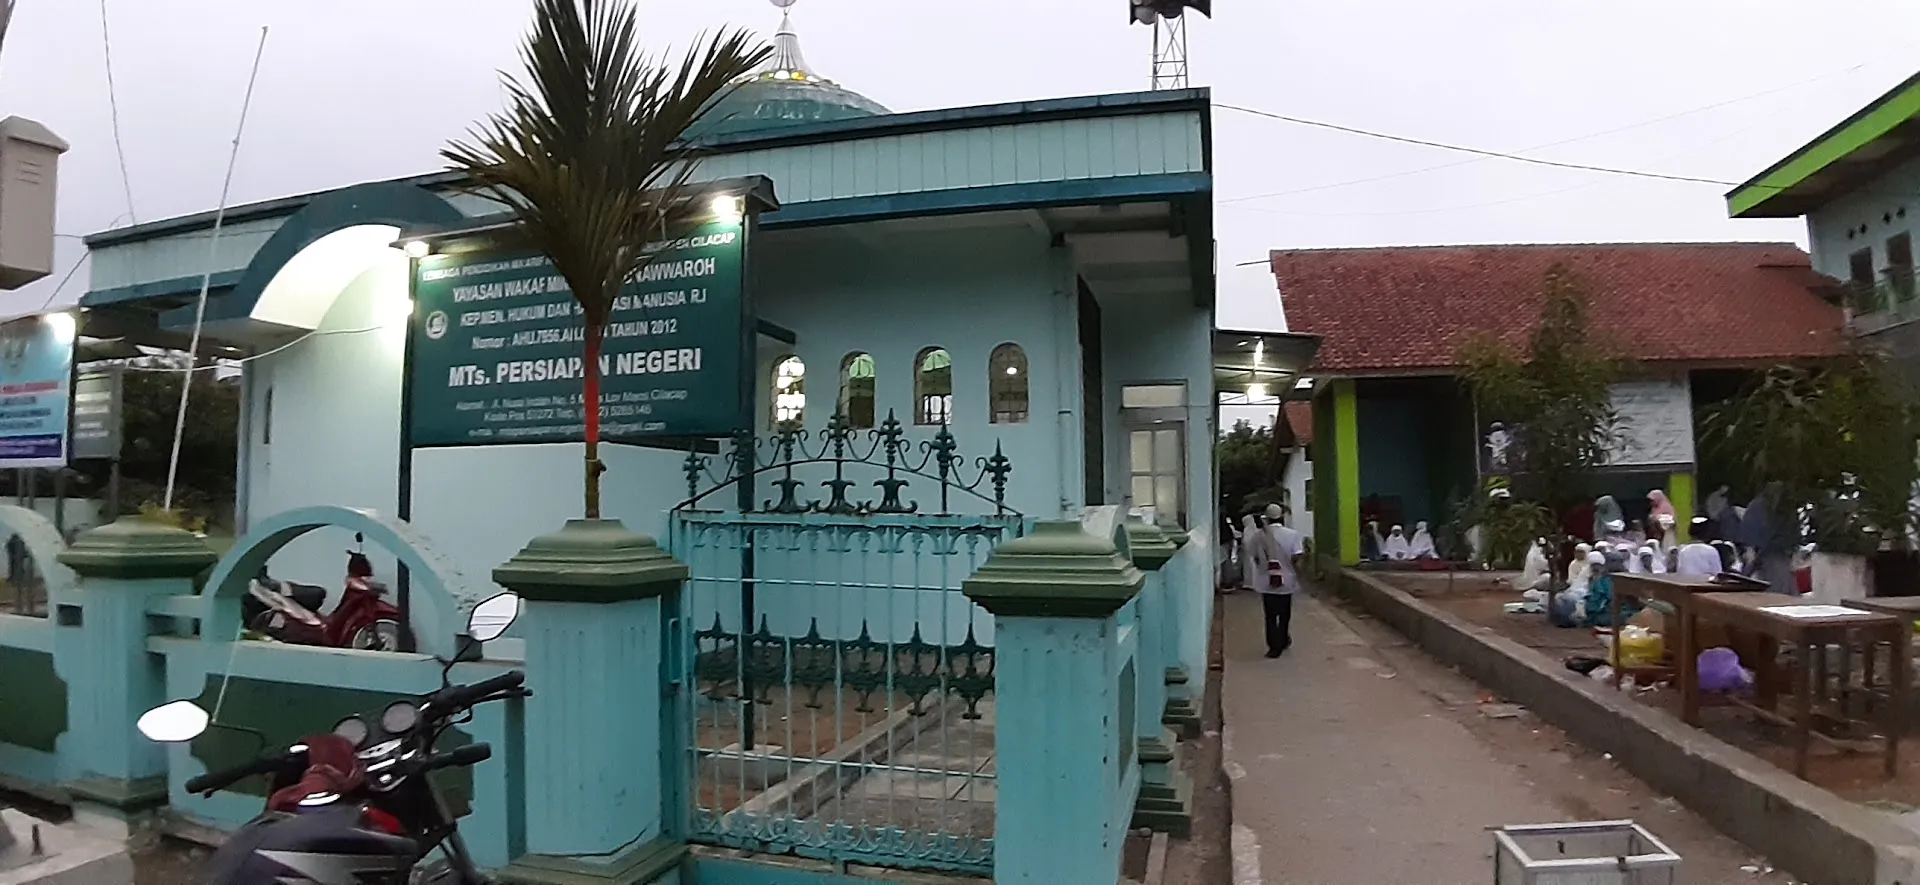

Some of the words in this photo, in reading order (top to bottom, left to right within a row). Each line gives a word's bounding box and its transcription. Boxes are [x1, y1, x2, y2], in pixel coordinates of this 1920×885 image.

[691, 232, 736, 248] CILACAP
[453, 283, 503, 302] YAYASAN
[504, 277, 546, 297] WAKAF
[507, 304, 546, 322] HUKUM
[547, 301, 571, 318] DAN
[610, 320, 648, 338] TAHUN
[650, 318, 678, 334] 2012
[448, 364, 491, 387] MTs.
[496, 354, 611, 384] PERSIAPN
[616, 347, 702, 375] NEGERI
[651, 389, 688, 401] Cilacap
